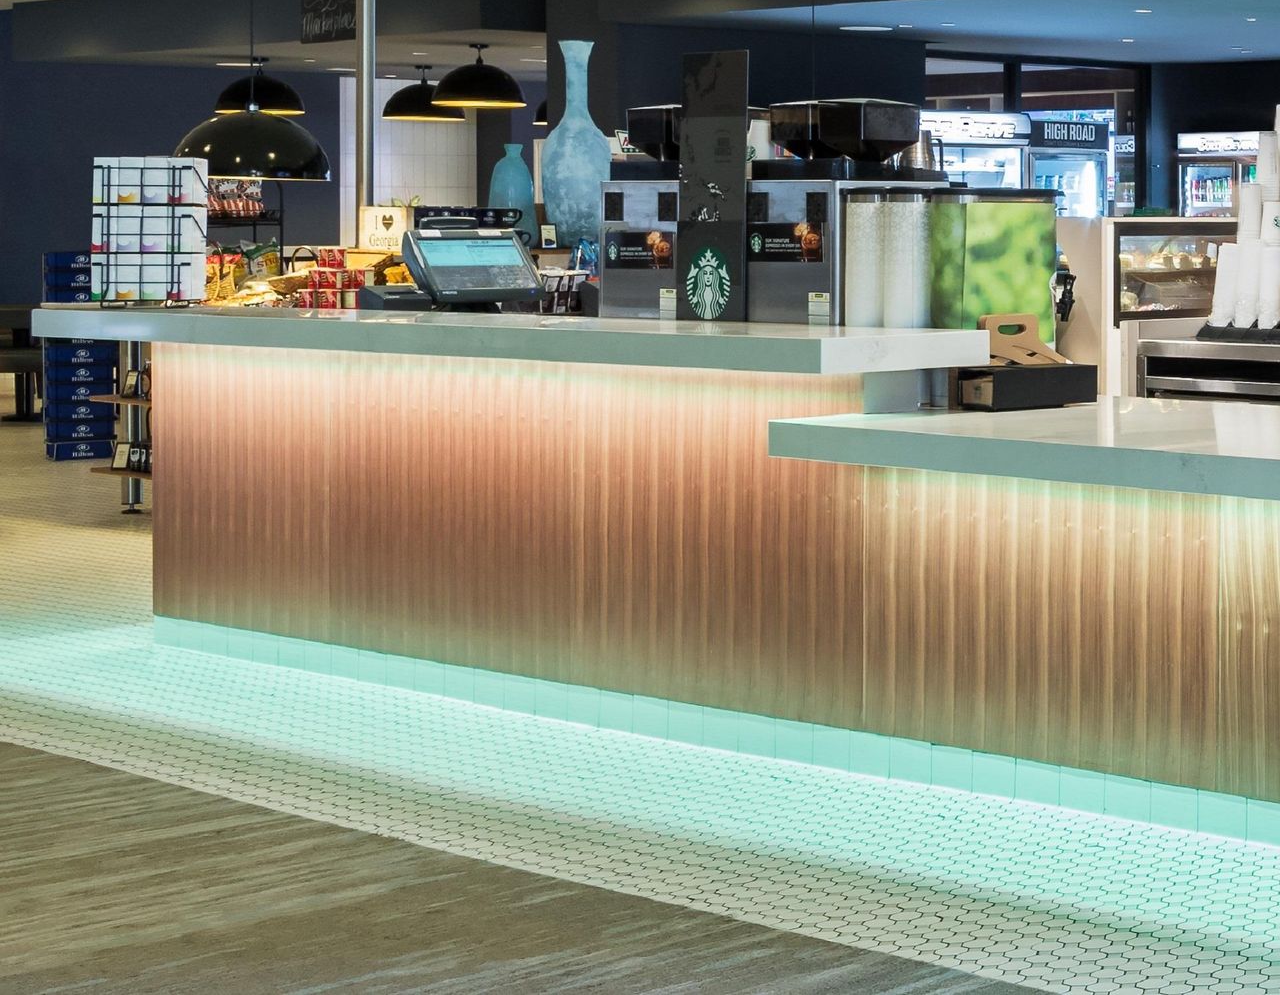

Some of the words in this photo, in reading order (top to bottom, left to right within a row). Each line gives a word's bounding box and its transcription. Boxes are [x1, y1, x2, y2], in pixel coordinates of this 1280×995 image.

[1044, 122, 1068, 140] HIGH
[1069, 124, 1096, 142] ROAD
[369, 234, 399, 250] Georgia
